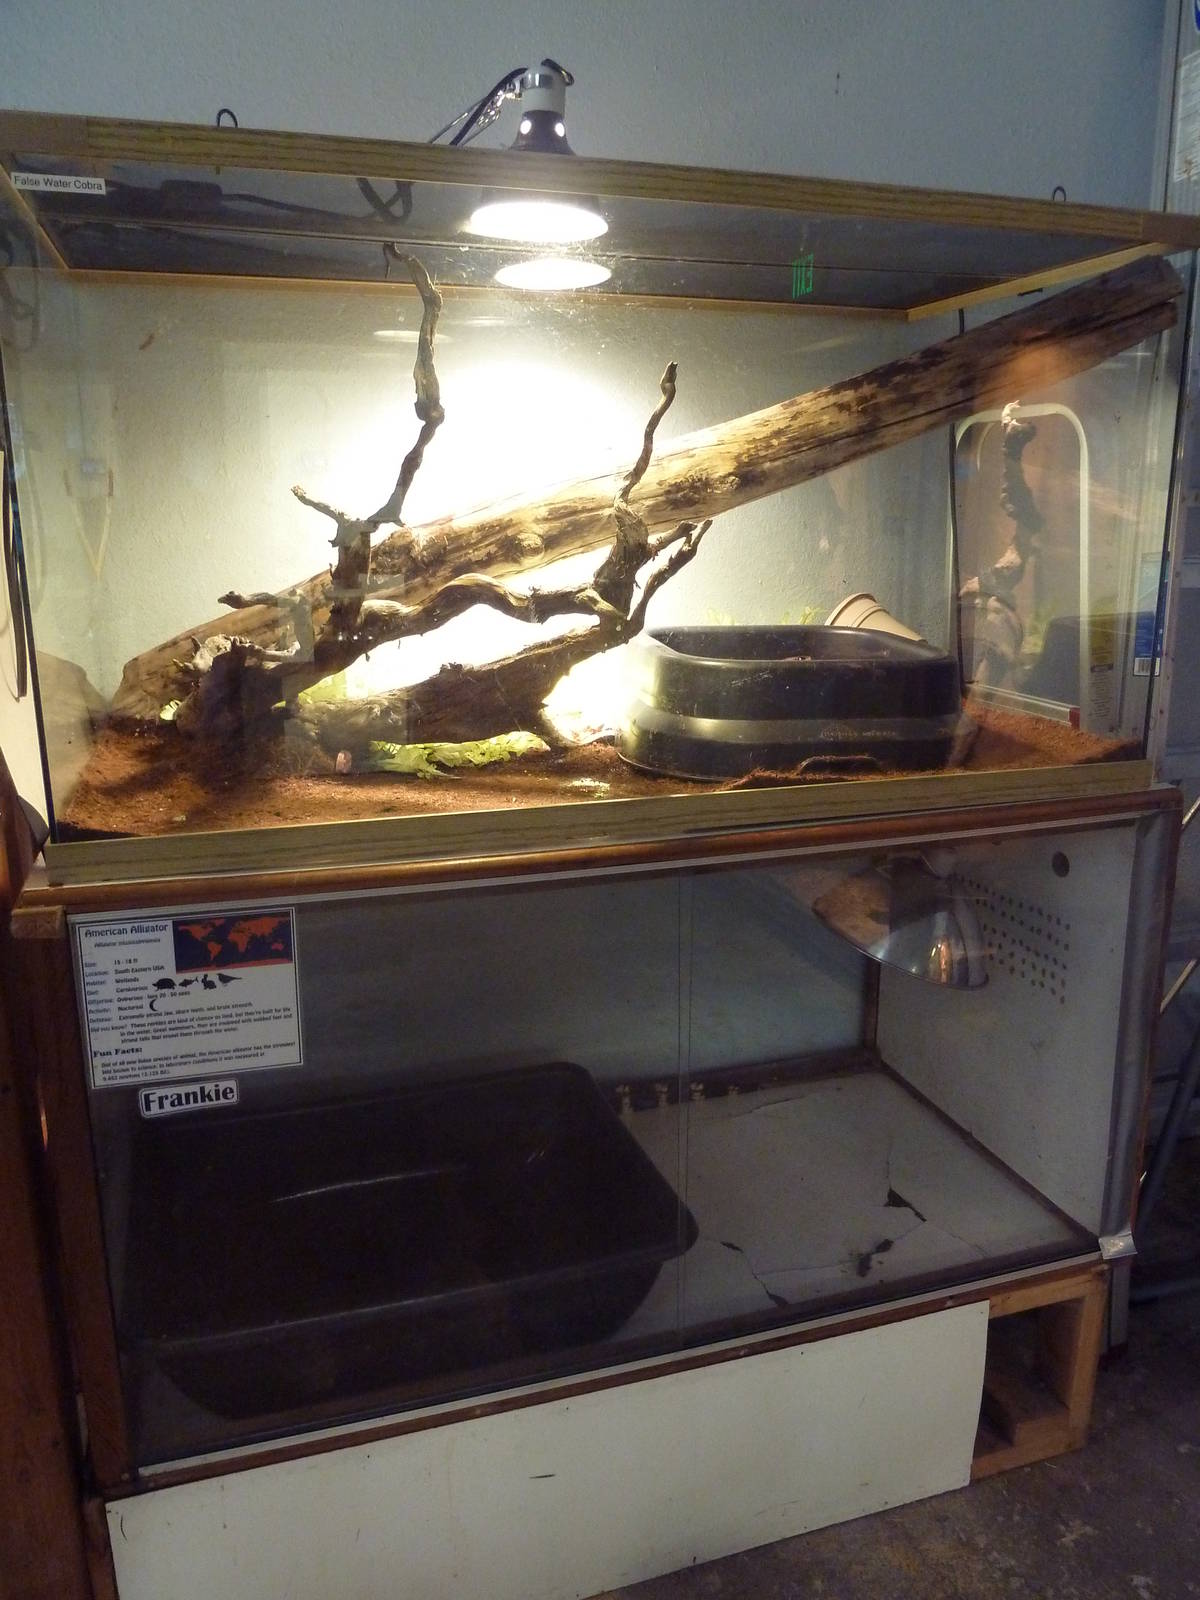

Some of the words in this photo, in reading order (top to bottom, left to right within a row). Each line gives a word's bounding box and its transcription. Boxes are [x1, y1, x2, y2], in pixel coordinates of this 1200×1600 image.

[14, 175, 40, 186] False
[43, 178, 71, 188] Water
[73, 179, 102, 191] Cobra
[84, 926, 128, 938] American
[130, 923, 168, 934] Alligator
[93, 1049, 112, 1057] Fun
[114, 1045, 142, 1055] Facts:
[142, 1083, 235, 1112] Frankie
